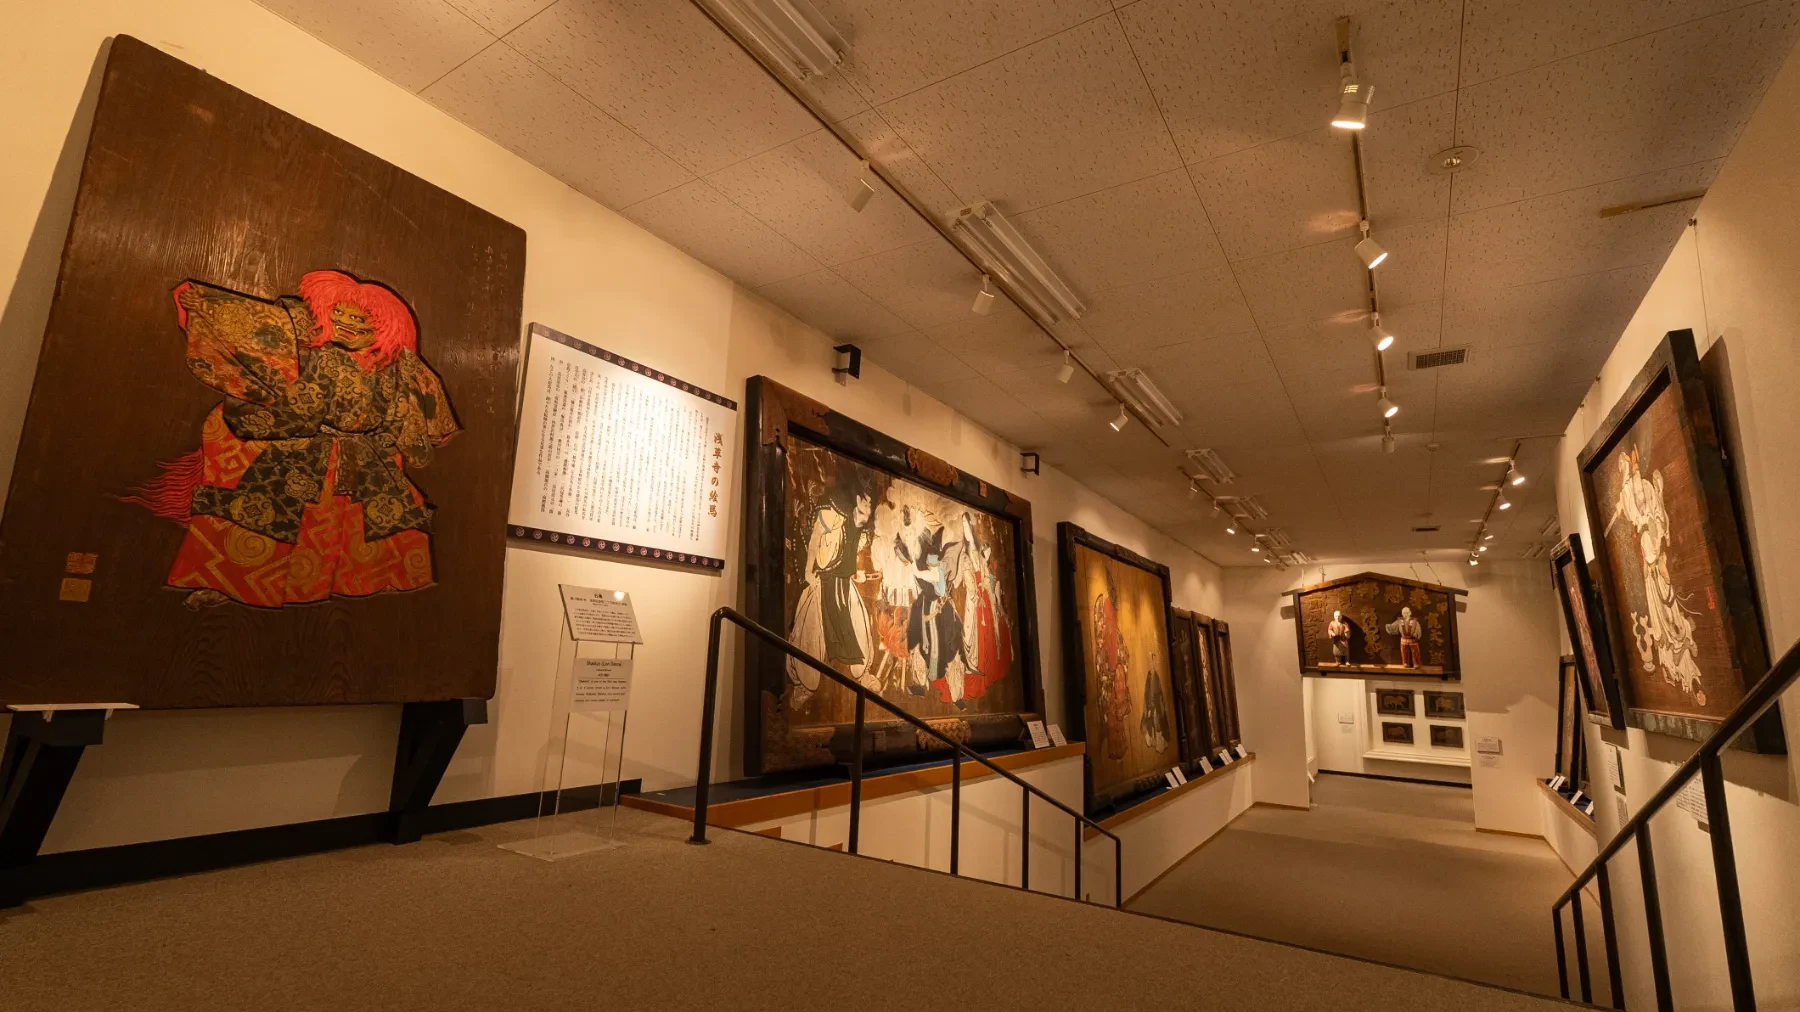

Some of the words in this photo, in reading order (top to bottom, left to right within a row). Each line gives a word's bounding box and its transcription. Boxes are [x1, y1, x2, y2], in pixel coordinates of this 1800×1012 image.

[708, 432, 723, 518] 浅草寺の絵馬
